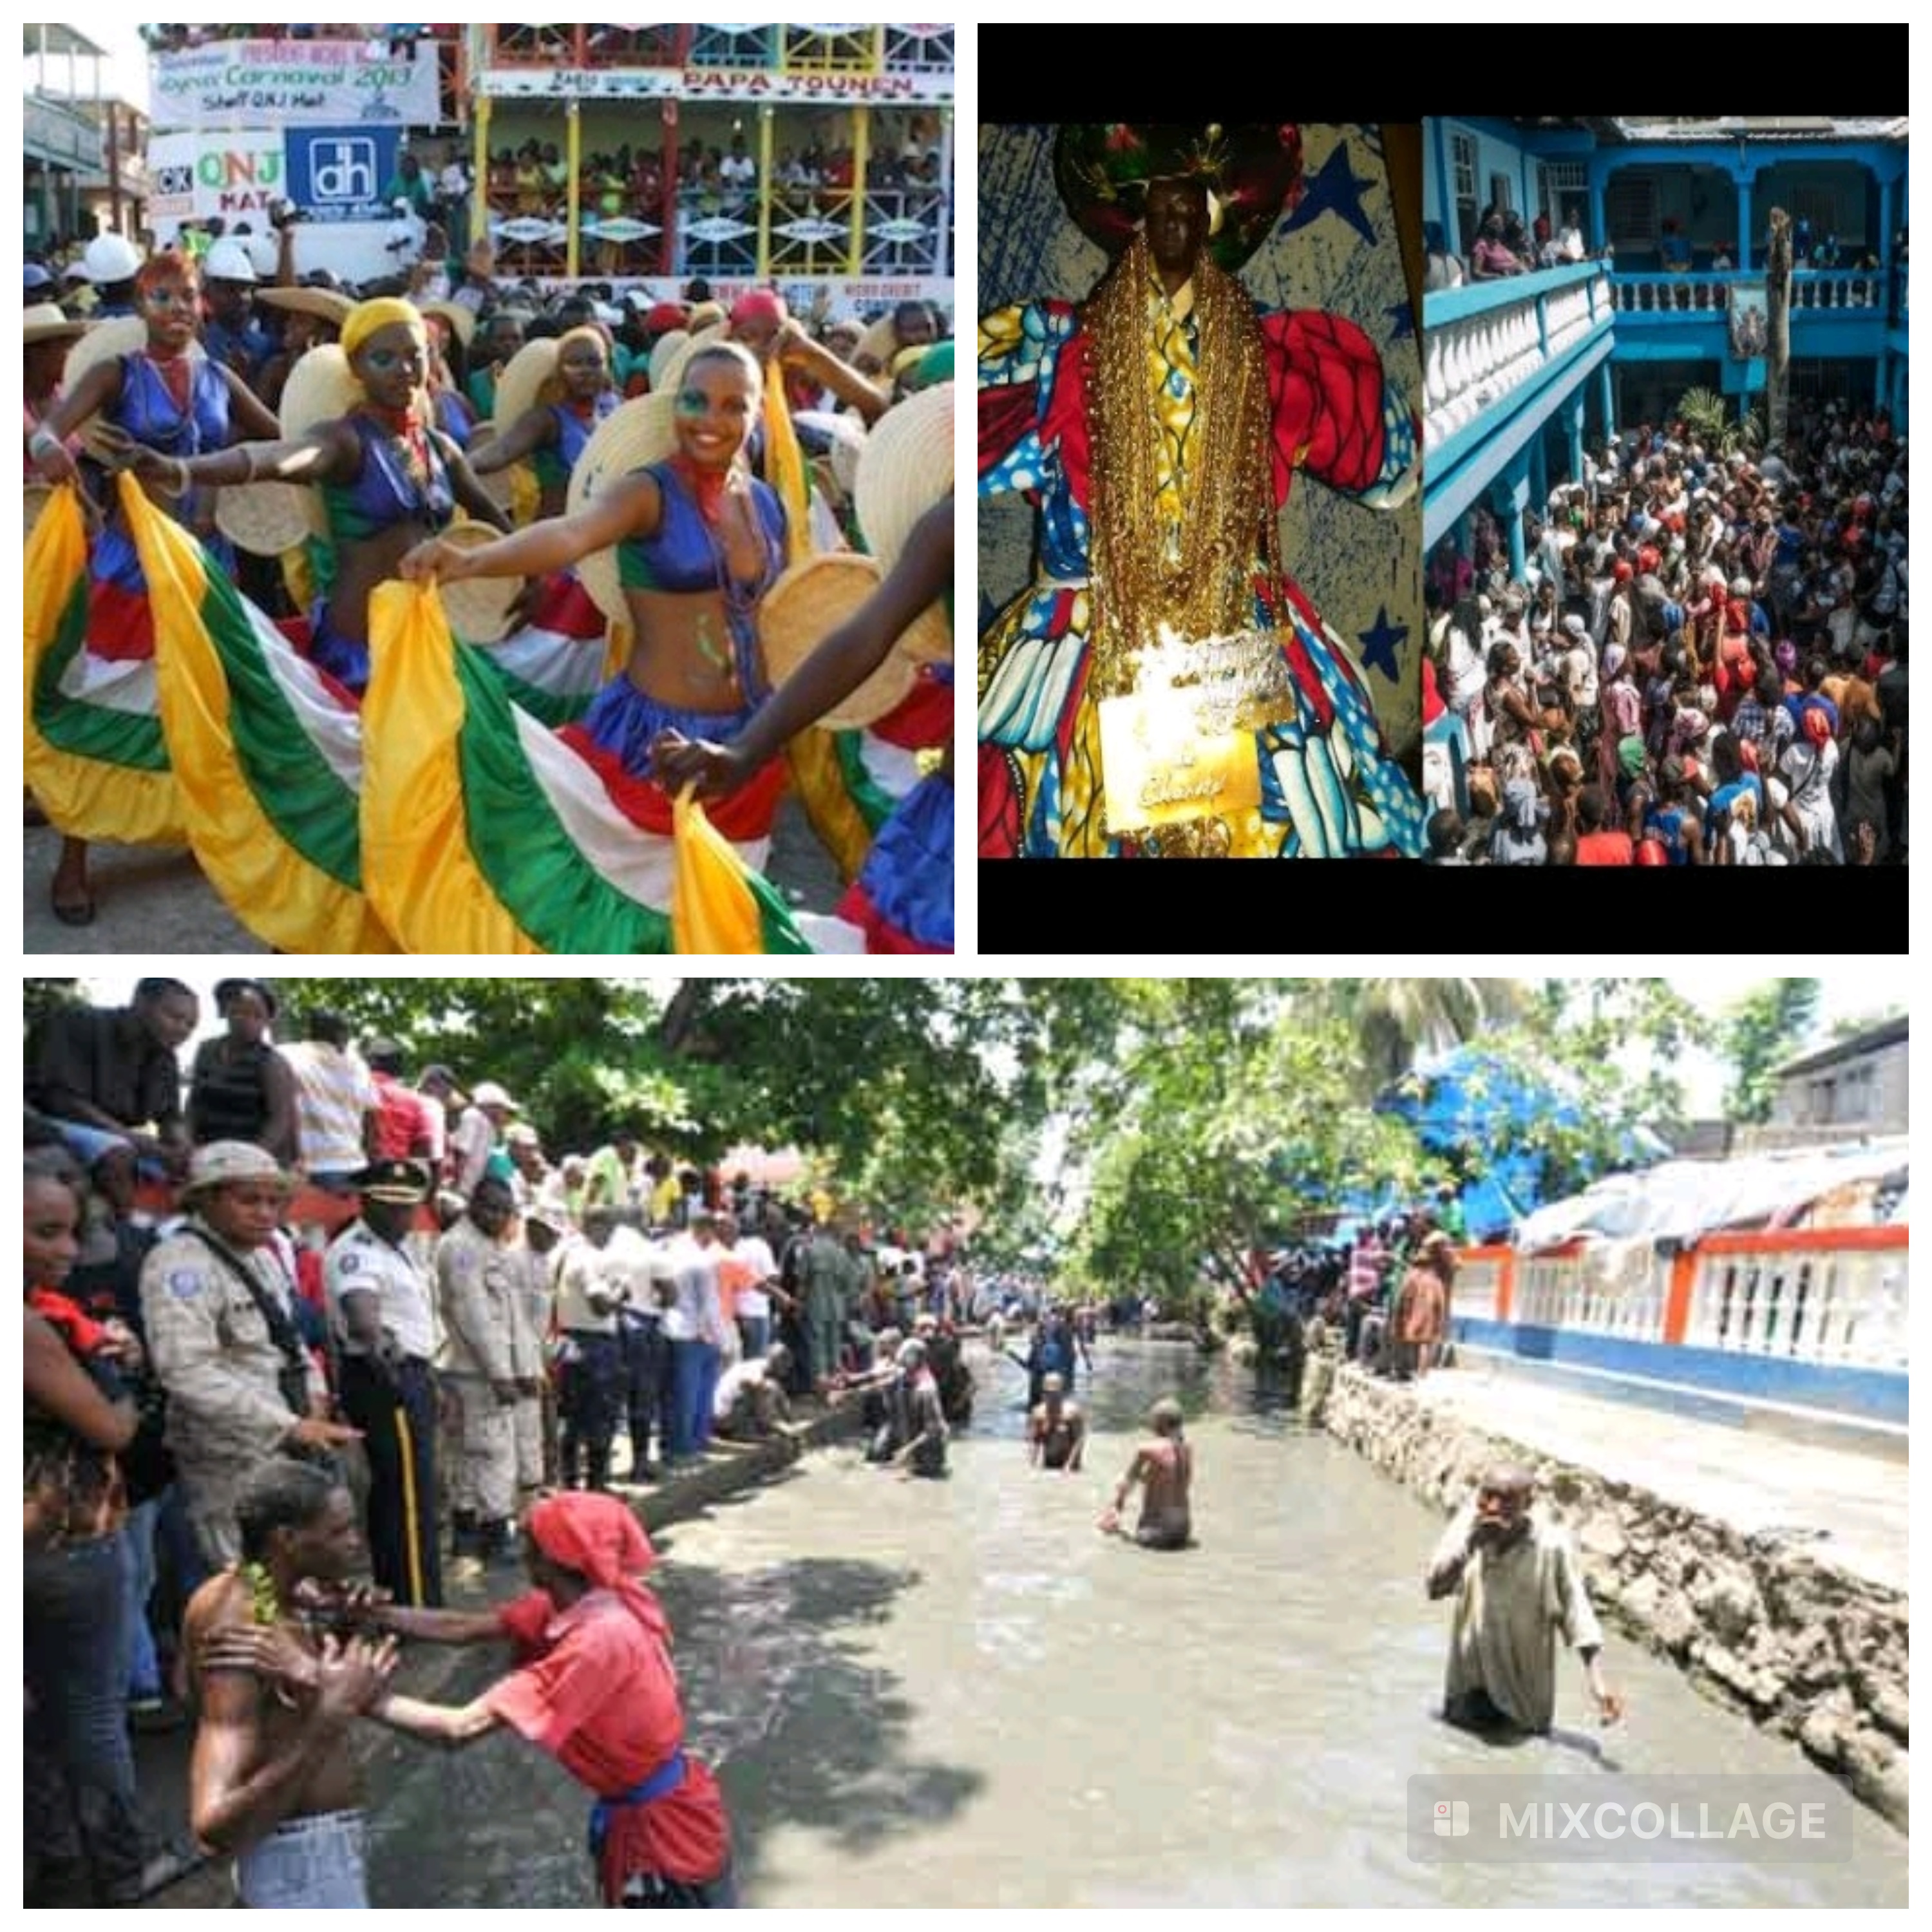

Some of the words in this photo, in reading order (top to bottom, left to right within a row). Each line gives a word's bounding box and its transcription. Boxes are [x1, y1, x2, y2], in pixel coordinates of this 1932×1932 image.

[226, 65, 345, 86] Carnaval
[682, 72, 770, 90] PAPA
[787, 75, 913, 92] TOUNEN
